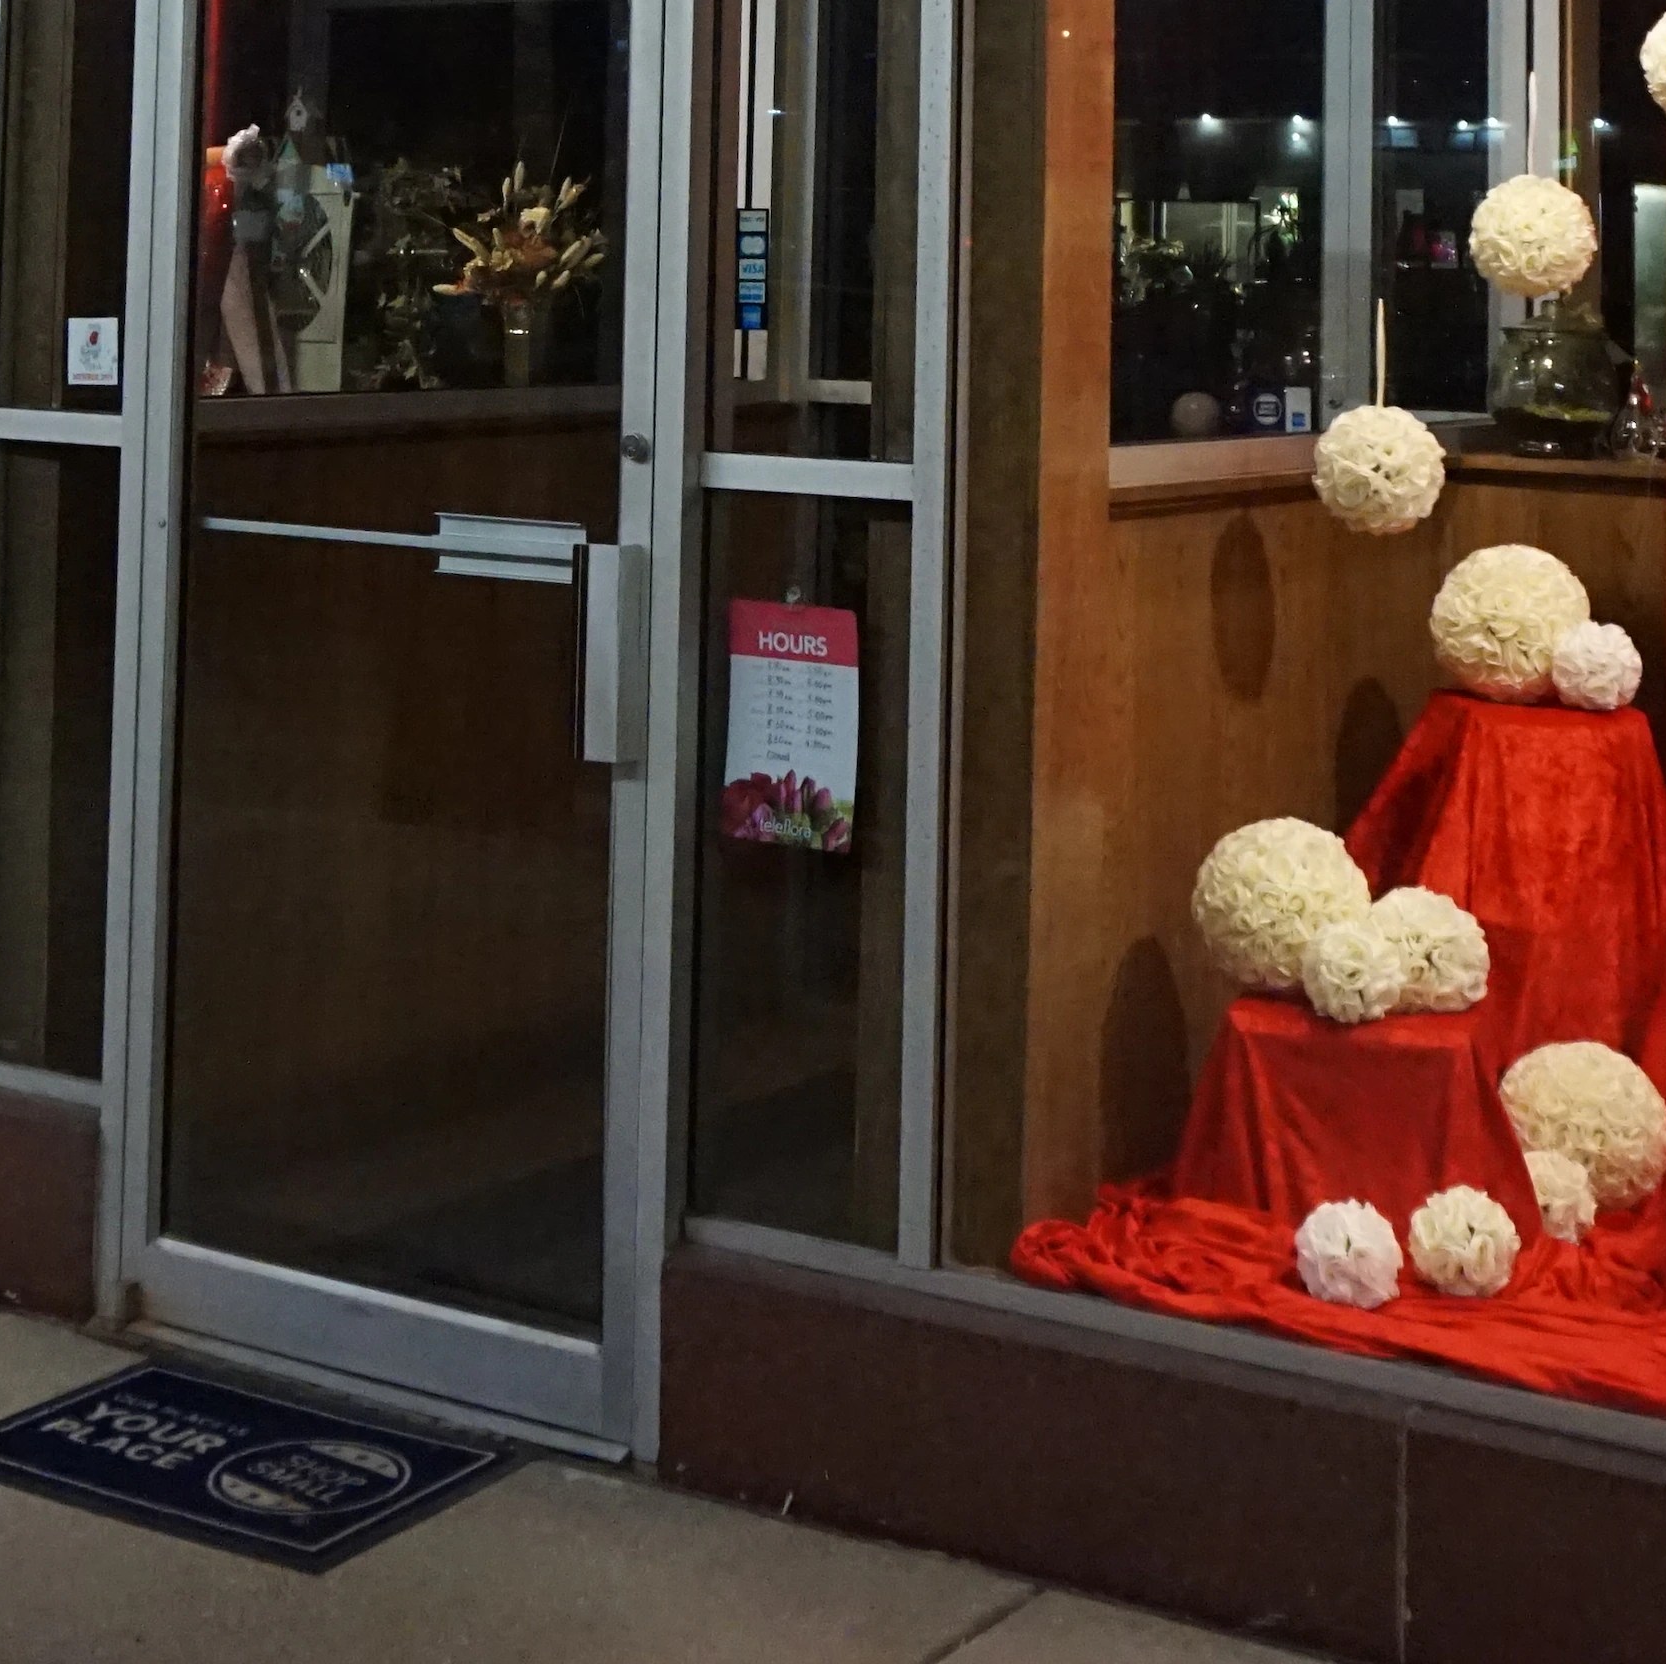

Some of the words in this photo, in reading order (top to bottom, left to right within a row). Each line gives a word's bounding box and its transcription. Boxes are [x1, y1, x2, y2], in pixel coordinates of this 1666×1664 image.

[758, 631, 829, 657] HOURS
[759, 815, 812, 838] teleflora
[39, 1418, 194, 1470] PLACE
[85, 1401, 227, 1454] YOUR
